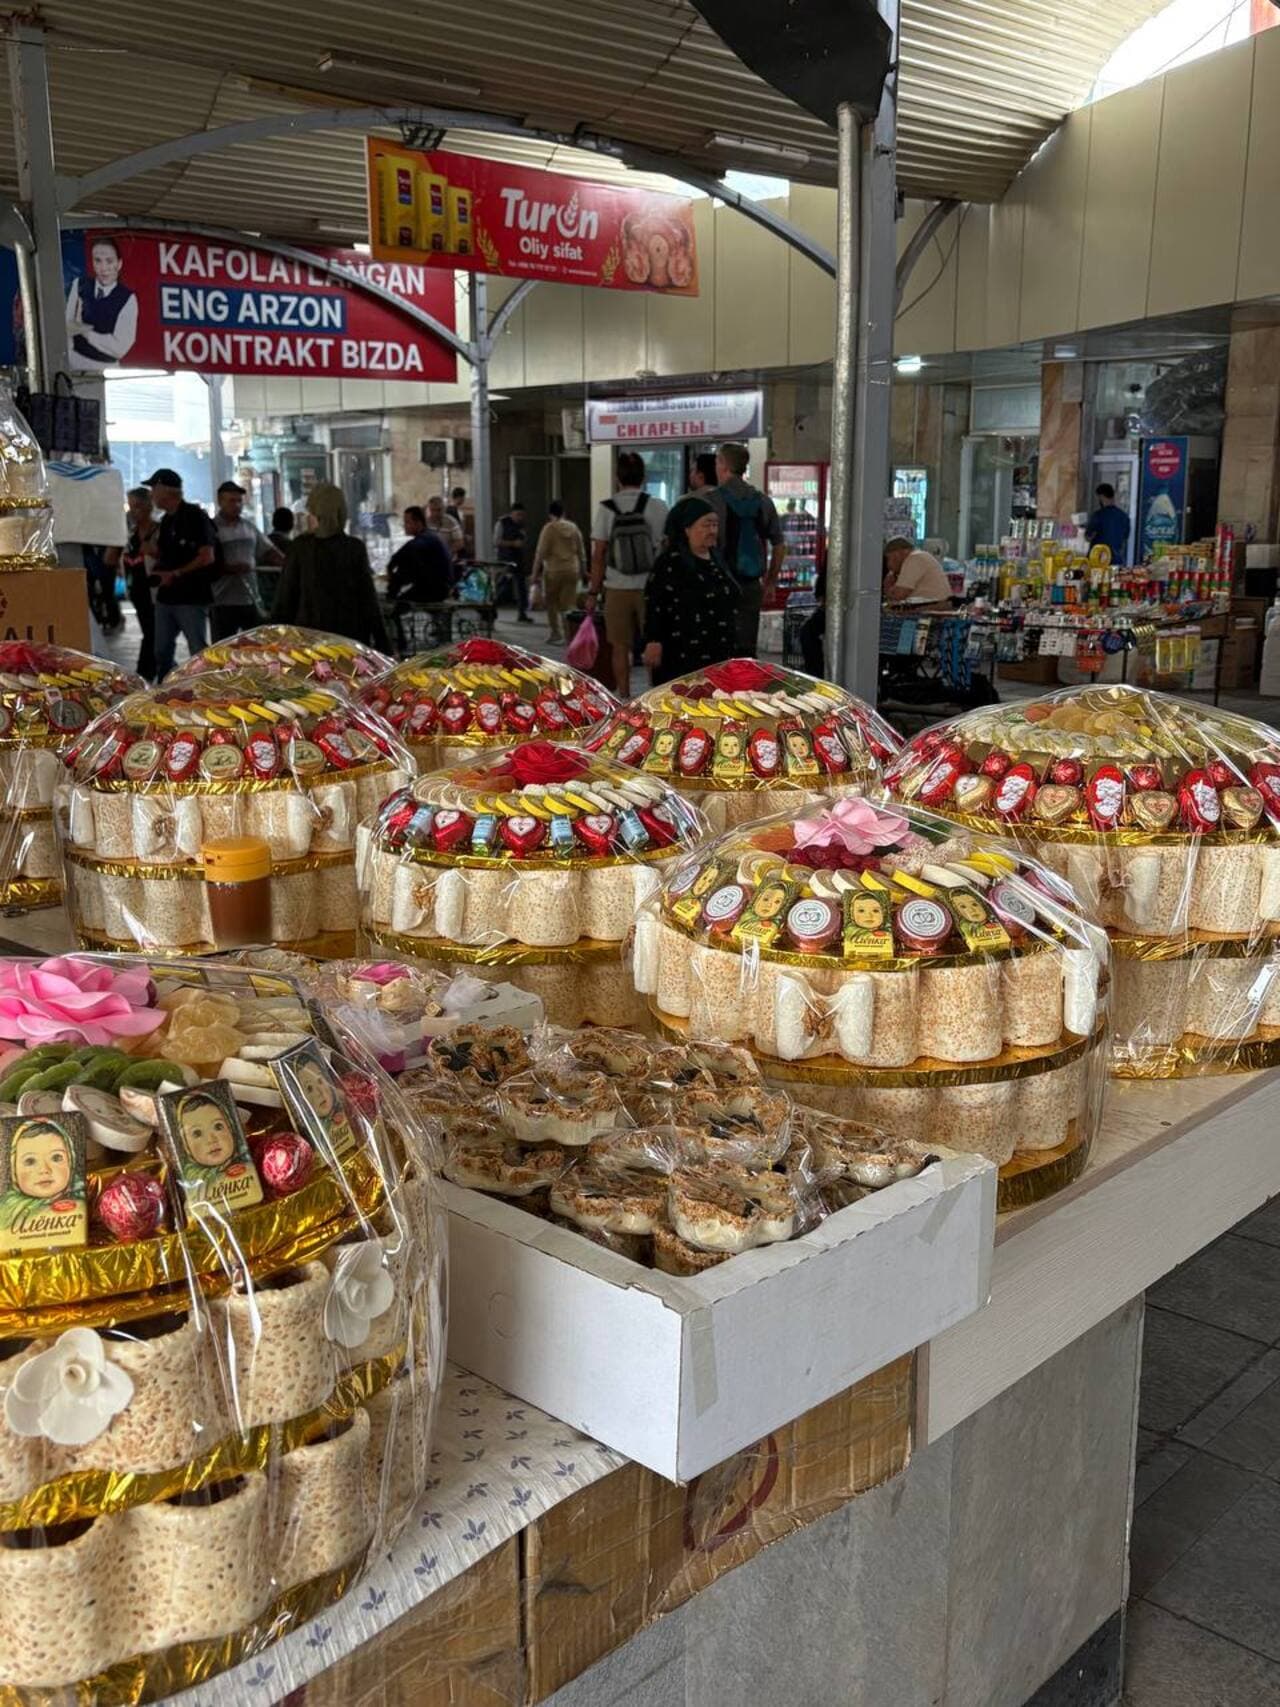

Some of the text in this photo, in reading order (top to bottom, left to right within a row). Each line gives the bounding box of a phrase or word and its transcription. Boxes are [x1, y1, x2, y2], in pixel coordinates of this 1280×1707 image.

[519, 236, 584, 261] Oliy sifat
[161, 287, 343, 328] ENG ARZON
[163, 331, 424, 372] KONTRAKT BIZDA
[616, 421, 705, 438] СИГАРЕТЫ
[11, 1206, 77, 1235] Алёнка
